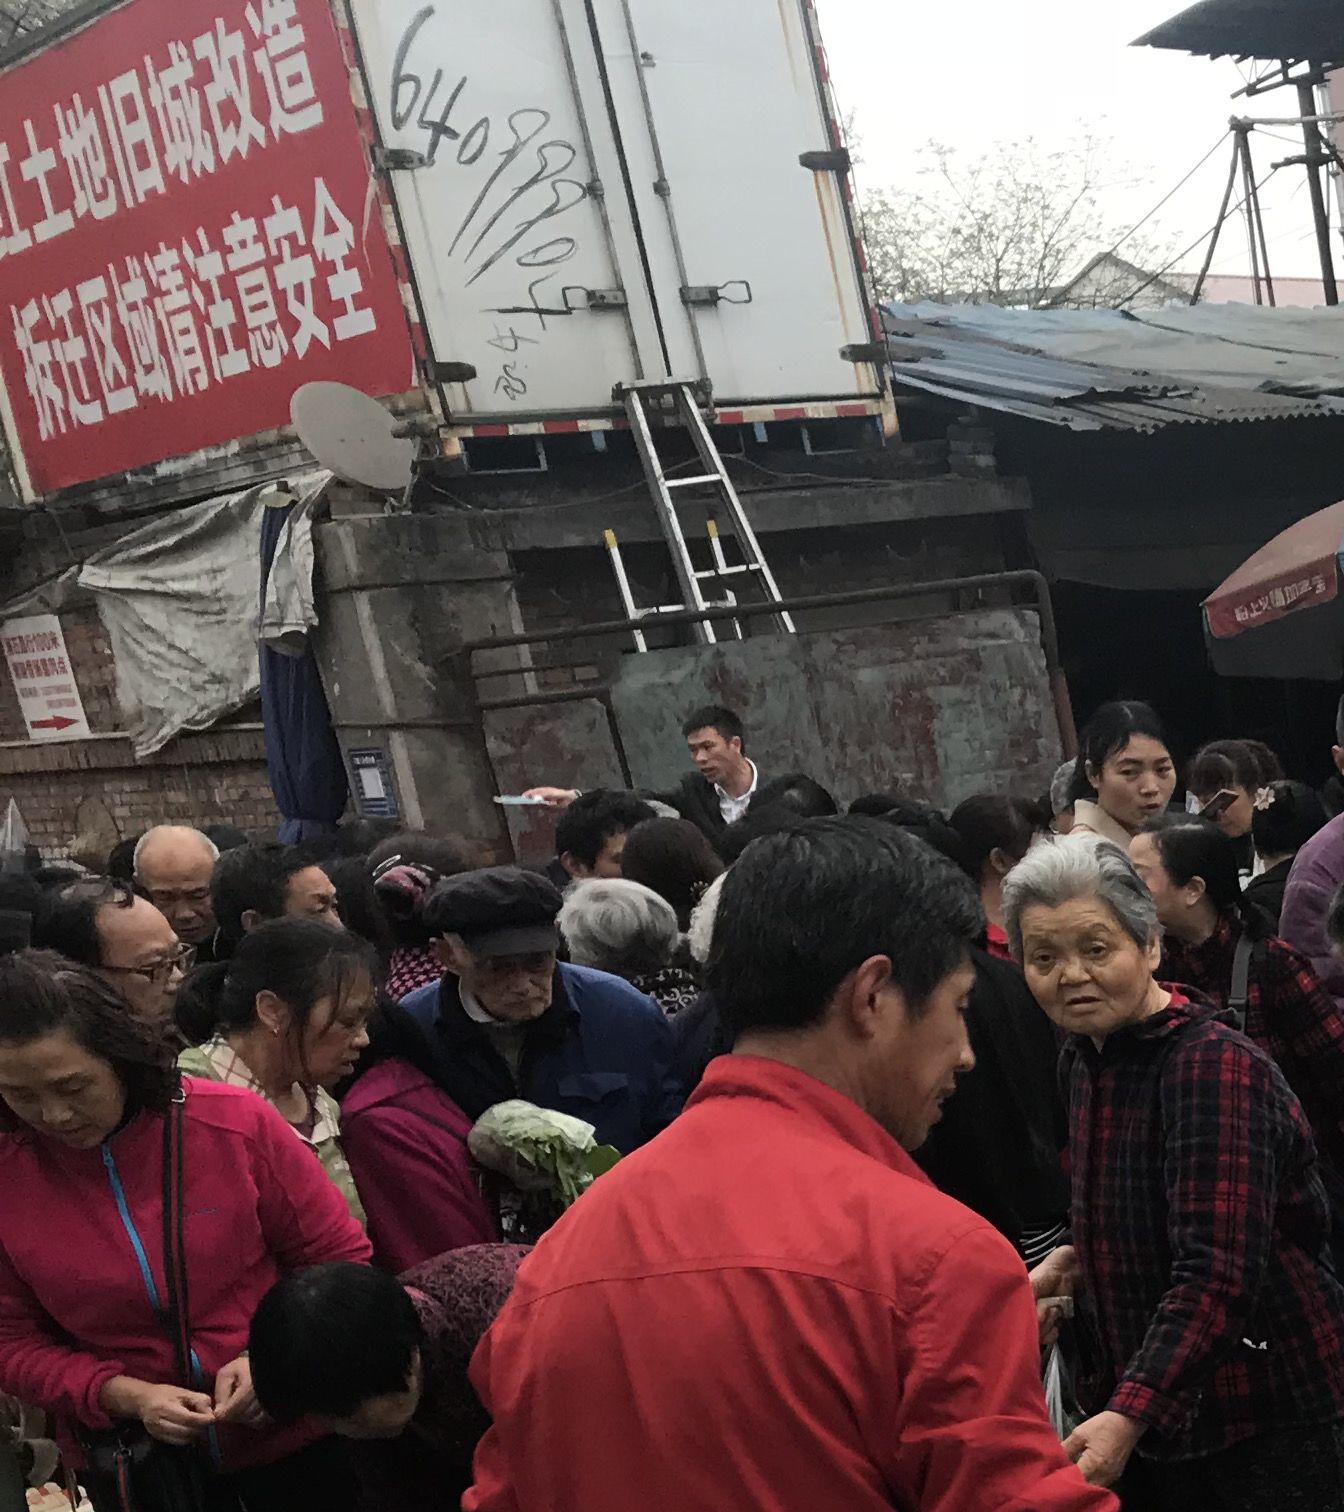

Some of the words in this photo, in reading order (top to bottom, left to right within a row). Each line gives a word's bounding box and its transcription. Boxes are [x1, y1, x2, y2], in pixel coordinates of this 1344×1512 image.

[10, 176, 377, 442] 拆迁区域请注意安全
